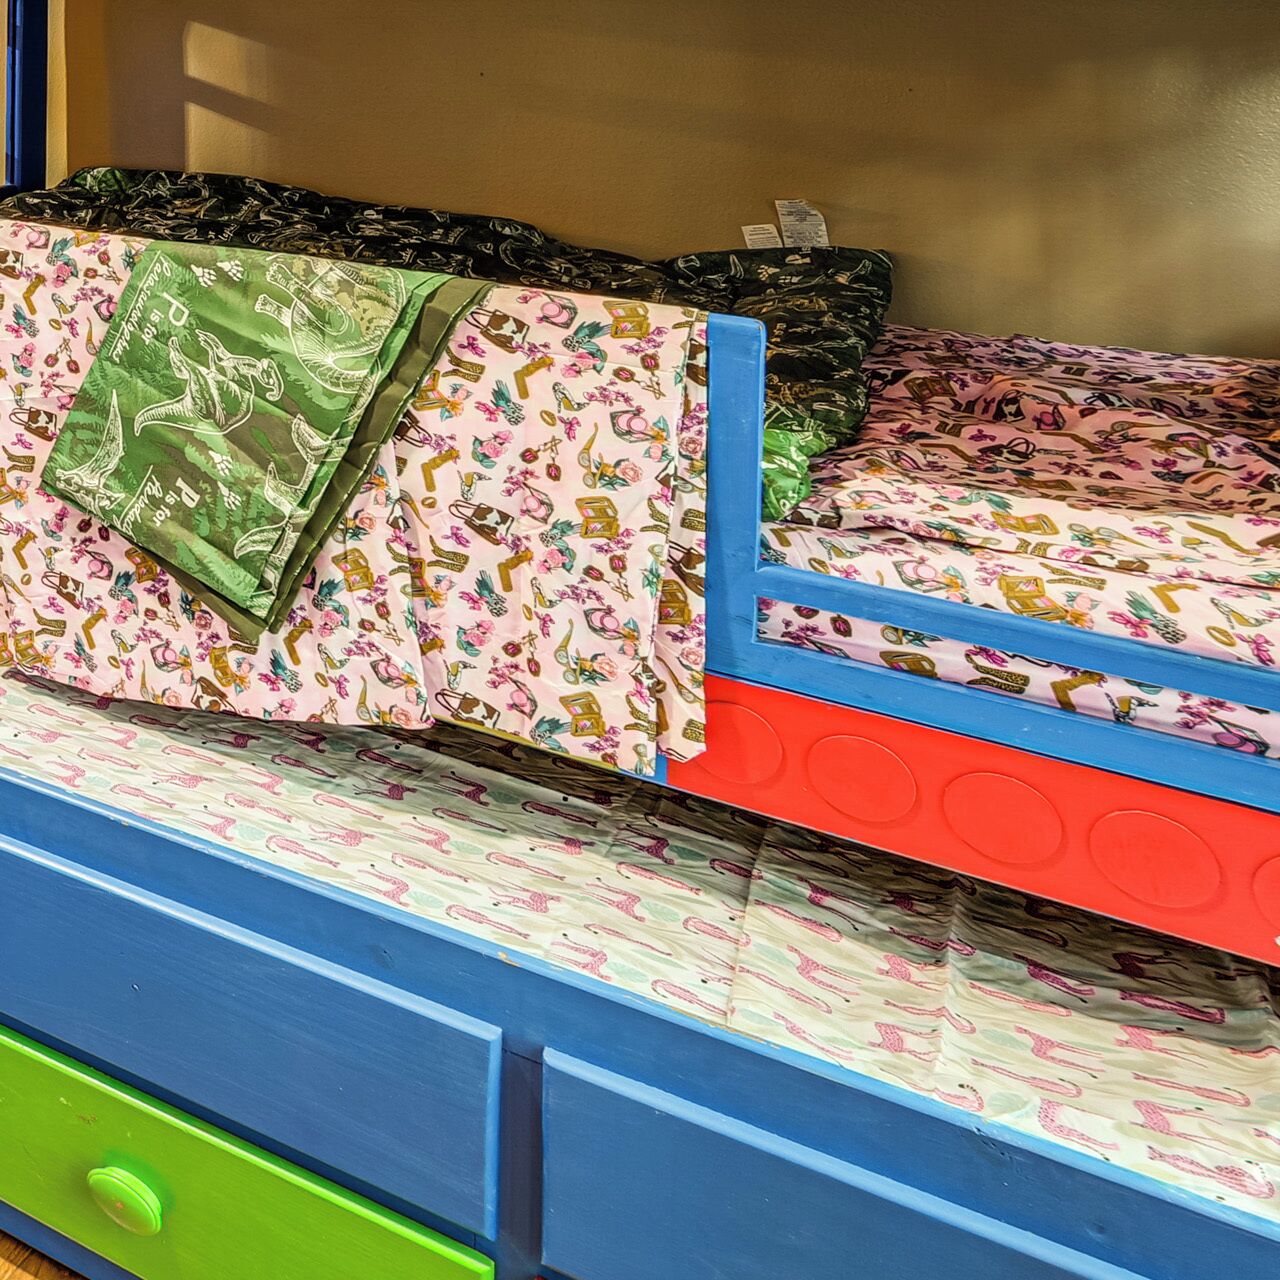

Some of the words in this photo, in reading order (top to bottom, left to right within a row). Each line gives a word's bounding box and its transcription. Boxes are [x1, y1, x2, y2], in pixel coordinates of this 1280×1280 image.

[150, 308, 164, 323] is
[163, 292, 189, 326] P
[141, 323, 157, 345] for
[165, 490, 180, 505] is
[175, 477, 200, 508] P
[152, 505, 171, 527] for
